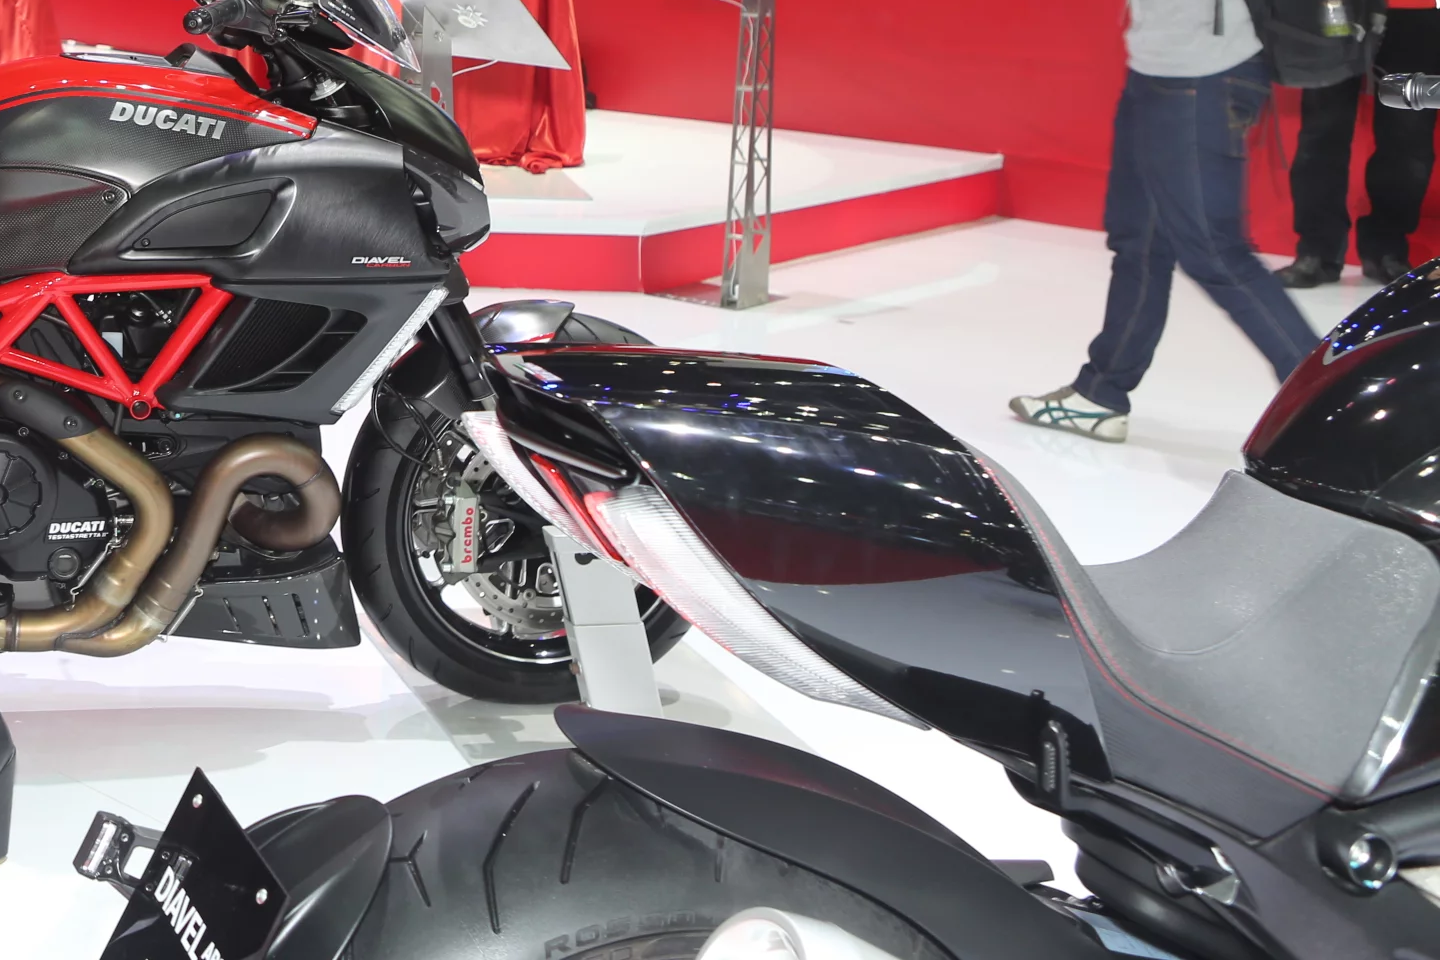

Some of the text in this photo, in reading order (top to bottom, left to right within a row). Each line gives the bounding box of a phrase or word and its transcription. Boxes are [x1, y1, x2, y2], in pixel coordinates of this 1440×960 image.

[109, 101, 227, 140] DUCATI
[351, 256, 412, 264] DIAVEL
[48, 533, 101, 541] TESTASTRETTA
[49, 521, 105, 534] DUCATI
[461, 507, 475, 565] brembo
[154, 865, 207, 960] DIAVEL
